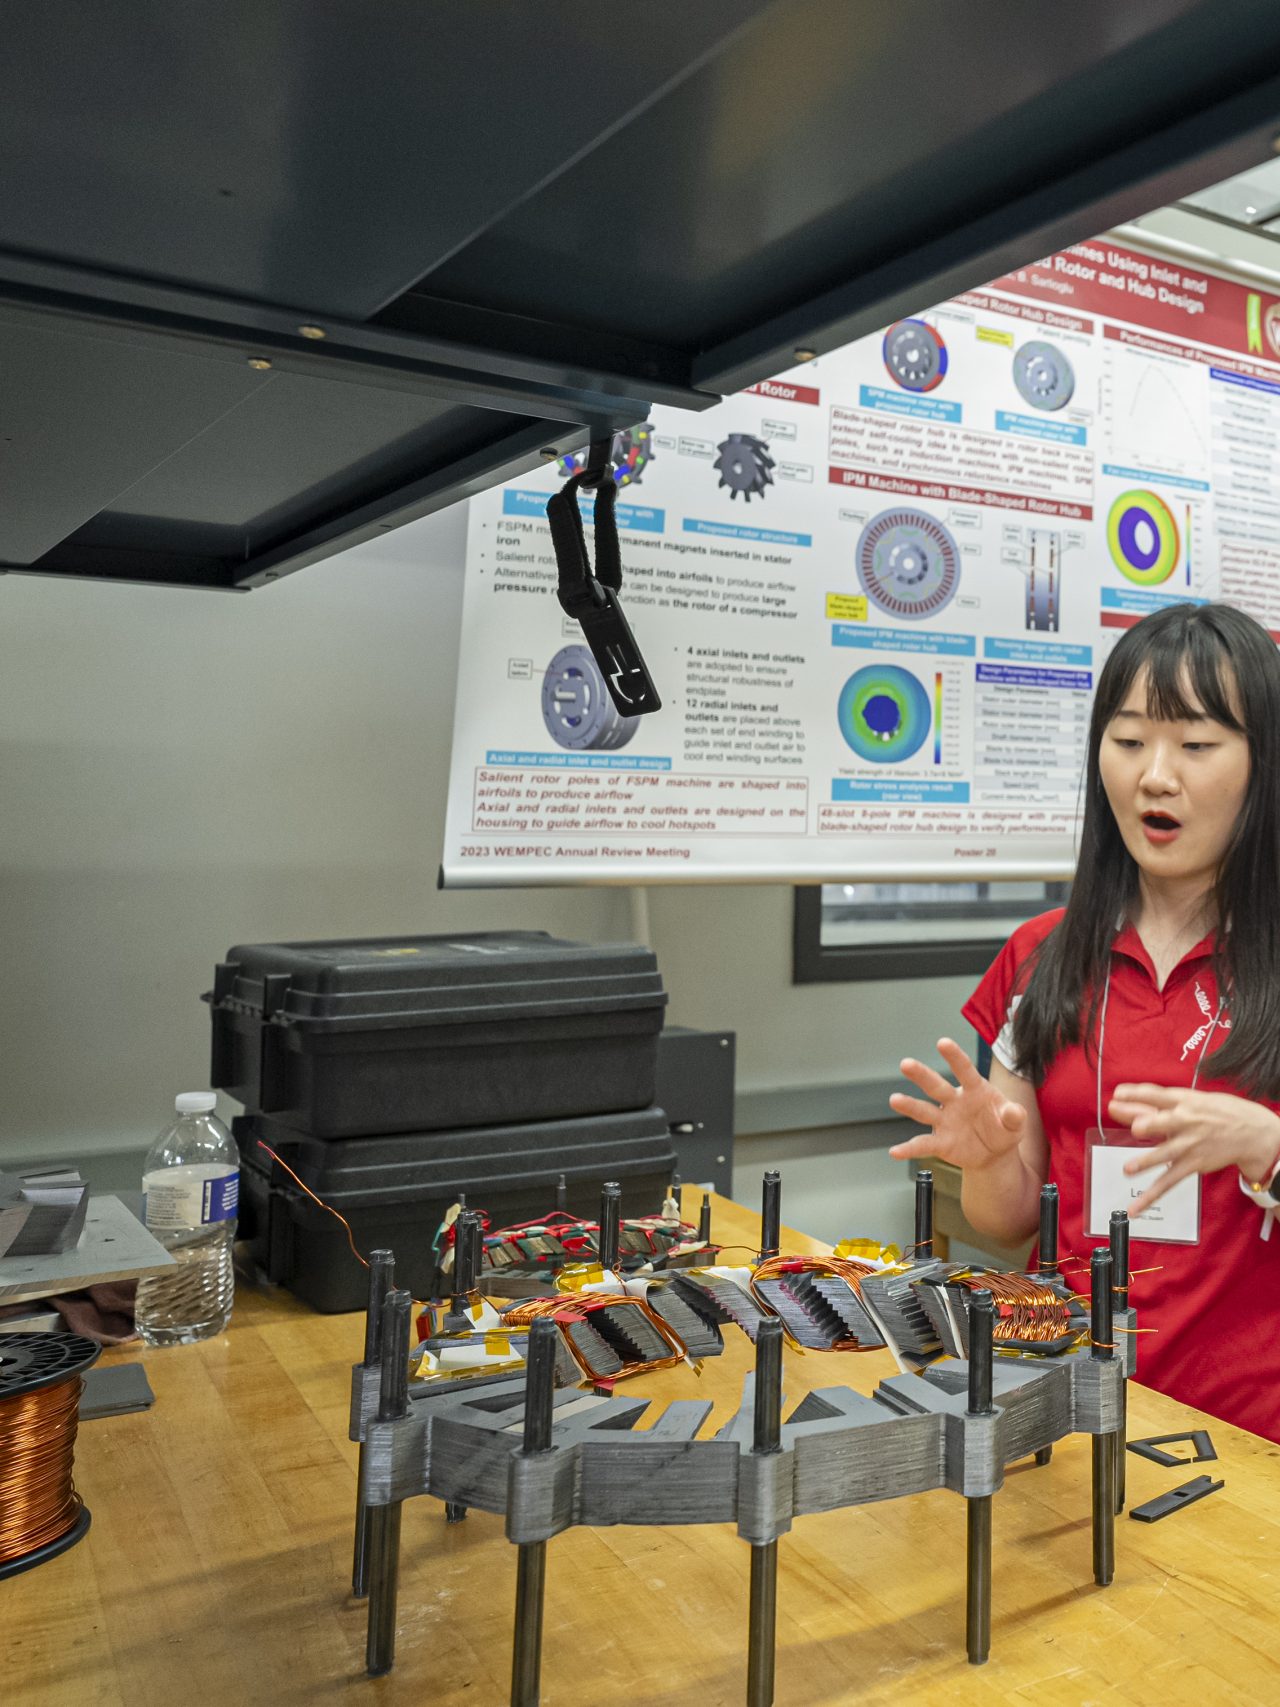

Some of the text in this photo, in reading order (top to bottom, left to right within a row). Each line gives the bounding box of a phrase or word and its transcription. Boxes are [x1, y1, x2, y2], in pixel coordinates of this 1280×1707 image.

[1107, 252, 1207, 294] Using Inlet and
[1054, 256, 1096, 281] Rotor
[1099, 271, 1125, 290] and
[1127, 278, 1156, 299] Hub
[1158, 287, 1204, 314] Design
[989, 298, 1019, 316] Rotor
[1021, 305, 1044, 322] Hub
[1045, 309, 1083, 330] Design
[760, 382, 797, 399] Rotor
[843, 471, 1082, 517] IPM Machine with Blade-Shaped Rotor Hub
[496, 536, 520, 546] iron
[497, 521, 533, 533] FSPM
[664, 542, 707, 555] magnets
[710, 546, 750, 560] inserted
[752, 551, 761, 561] in
[764, 553, 792, 565] stator
[495, 551, 796, 592] Salient into airfoils to produce airflow
[630, 581, 787, 606] can designed produce large
[493, 583, 547, 594] pressure
[658, 598, 670, 607] as
[673, 599, 689, 609] the
[691, 601, 716, 612] rotor
[719, 603, 729, 613] of
[740, 606, 798, 620] compressor
[687, 646, 806, 664] 4 axial inlets and outlets
[686, 661, 788, 675] are adopted ensure
[686, 673, 782, 687] structural robustness
[685, 687, 726, 696] endplate
[687, 699, 779, 713] 12 radial inlets and
[685, 713, 801, 727] outlets are placed above
[684, 726, 793, 740] each set end winding
[683, 740, 794, 751] guide inlet and outlet air
[489, 753, 669, 770] Axial and radial inlet and outlet design
[683, 753, 803, 765] cool end winding surfaces
[479, 771, 807, 791] Salient rotor poles of FSPM machine are shaped into
[478, 788, 633, 801] airfoils to produce airflow
[476, 802, 806, 819] Axial and radial inlets and outlets are designed on the
[476, 818, 717, 831] housing to guide airflow to cool hotspots
[460, 846, 691, 859] 2023 WEMPEC Annual Review Meeting
[954, 848, 983, 857] Poster
